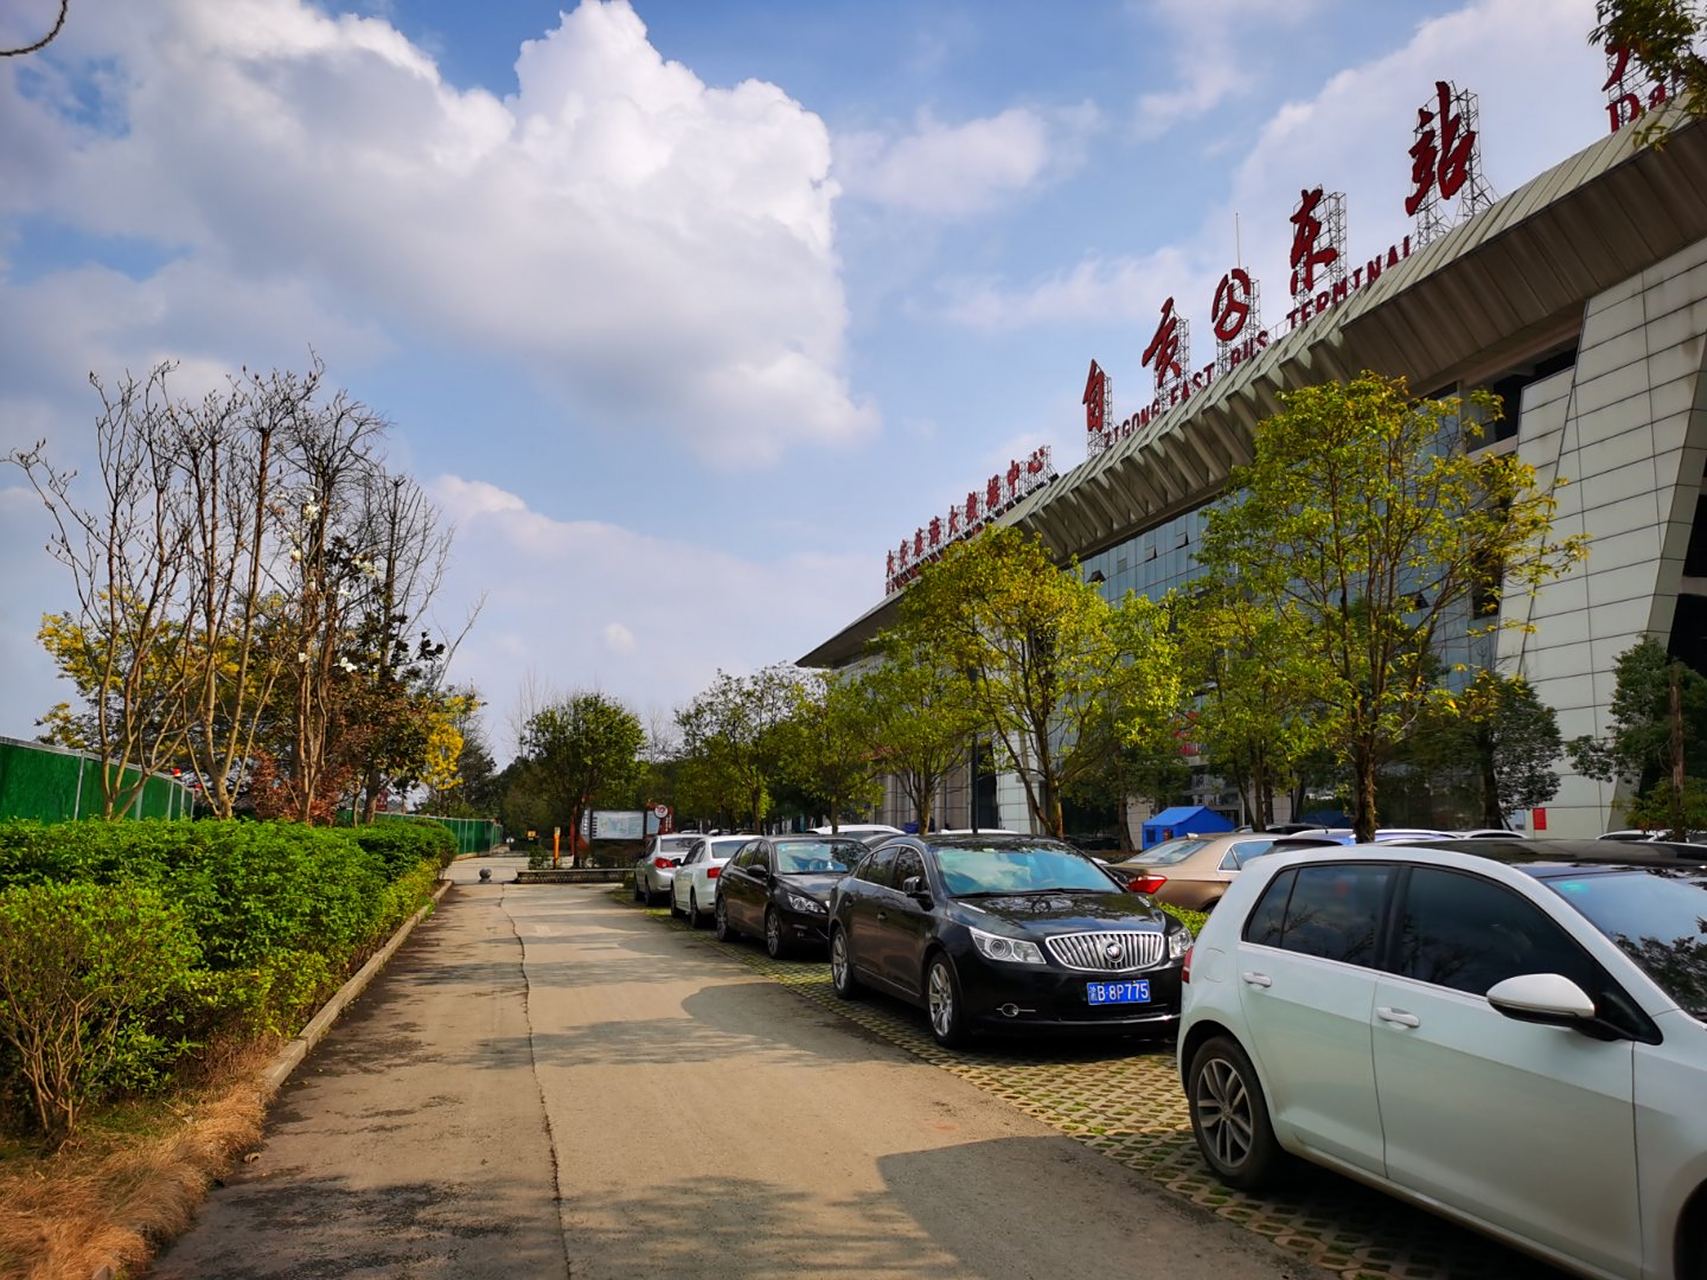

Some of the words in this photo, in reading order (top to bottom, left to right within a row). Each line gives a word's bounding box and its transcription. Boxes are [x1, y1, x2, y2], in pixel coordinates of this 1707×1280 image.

[1103, 398, 1161, 448] ZIGONG
[1170, 362, 1215, 405] EAST
[1231, 331, 1269, 370] BUS
[1286, 235, 1411, 329] TERMINAL
